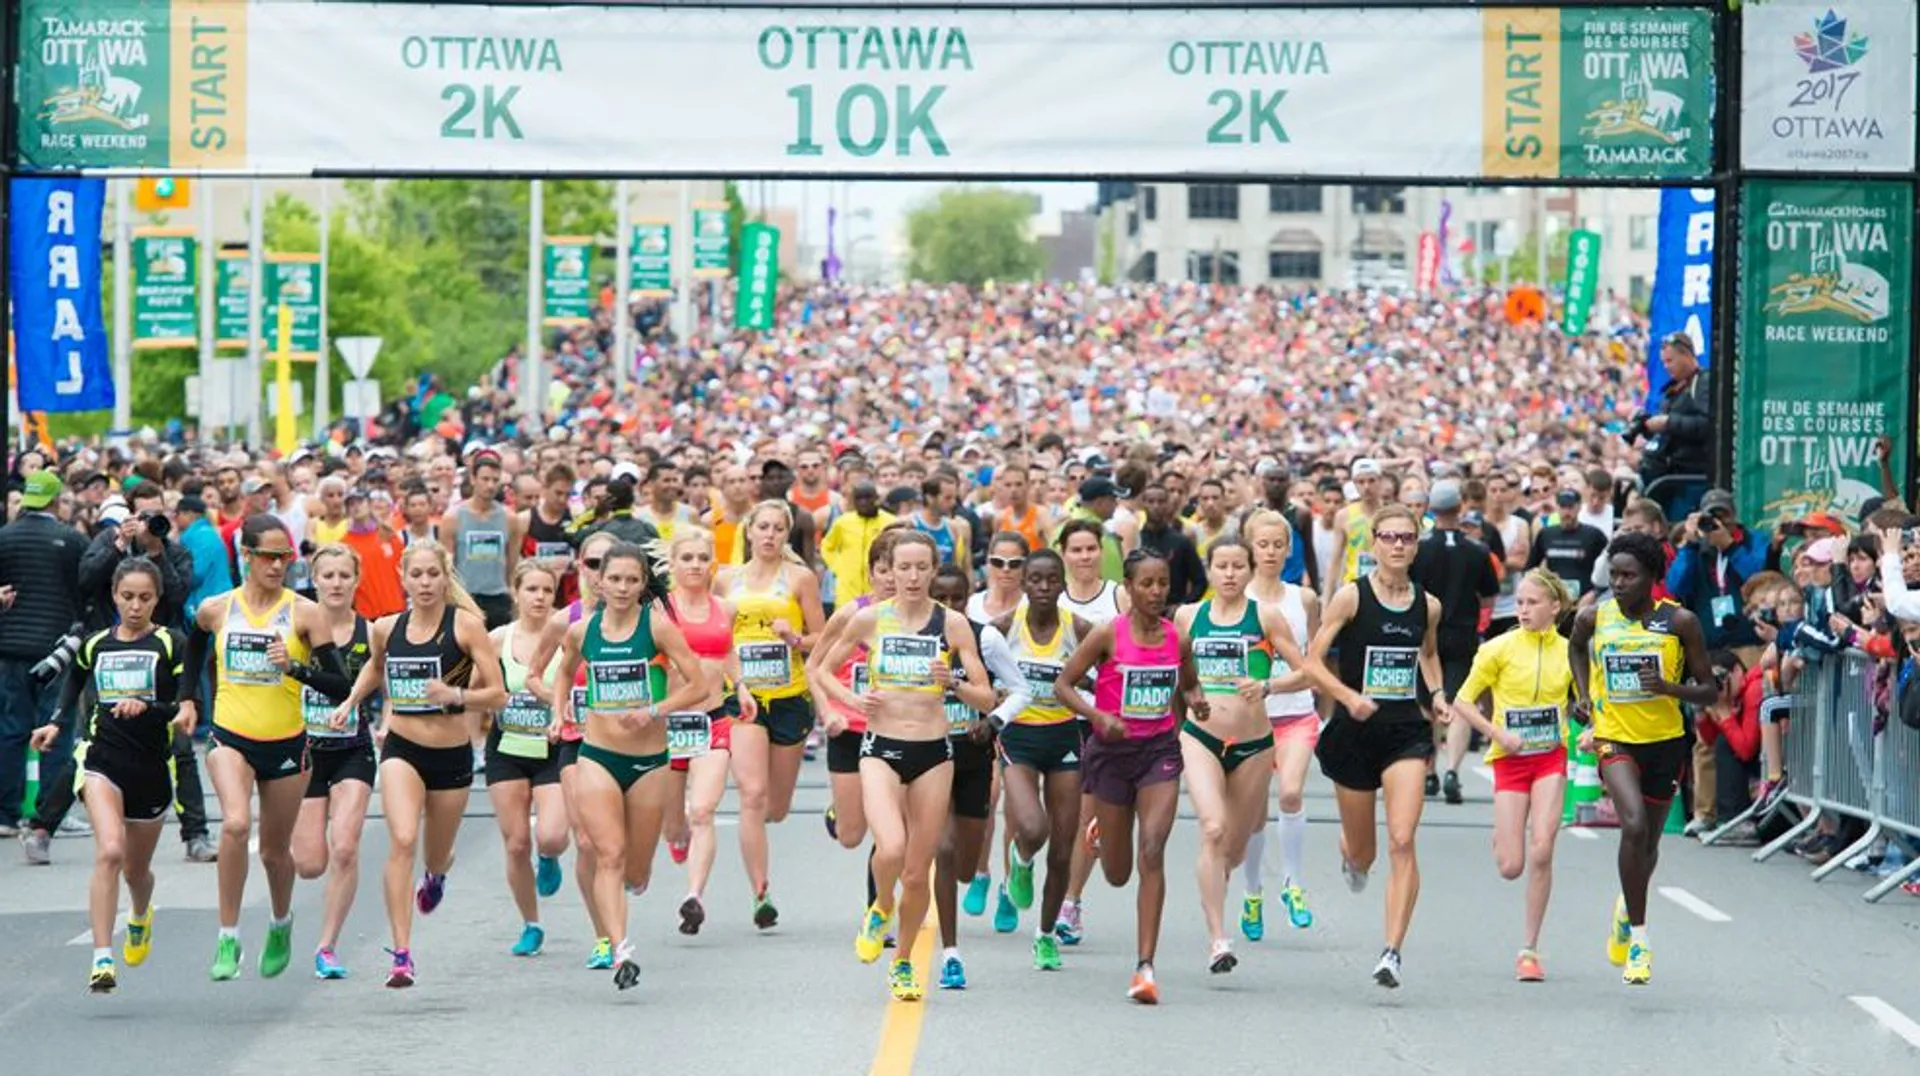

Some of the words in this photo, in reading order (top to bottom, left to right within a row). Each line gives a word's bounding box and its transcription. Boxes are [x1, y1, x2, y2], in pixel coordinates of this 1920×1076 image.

[44, 17, 147, 37] TAMARACK
[1584, 21, 1606, 34] FIN
[1610, 21, 1626, 34] DE
[1630, 21, 1689, 34] SEMAINE
[757, 25, 974, 71] OTTAWA
[1584, 35, 1612, 48] DES
[1620, 35, 1689, 48] COURSES
[401, 35, 563, 72] OTTAWA
[1167, 40, 1329, 76] OTTAWA
[190, 16, 228, 151] START
[1506, 23, 1543, 160] START
[1788, 71, 1861, 112] 2017
[440, 84, 524, 140] 2K
[785, 84, 952, 158] 10K
[1205, 88, 1291, 144] 2K
[1772, 116, 1883, 139] OTTAWA
[41, 134, 75, 149] RACE
[81, 134, 148, 149] WEEKEND
[1583, 143, 1688, 164] TAMARACK
[1765, 325, 1805, 341] RACE
[1812, 325, 1888, 342] WEEKEND
[1763, 400, 1787, 415] FIN
[1793, 401, 1812, 416] DE
[1817, 402, 1885, 417] SEMAINE
[1762, 417, 1795, 432] DES
[1804, 418, 1884, 433] COURSES
[884, 656, 932, 675] DAVIES
[391, 678, 429, 699] FRASE
[1130, 687, 1171, 706] DADO
[667, 730, 705, 747] COTE
